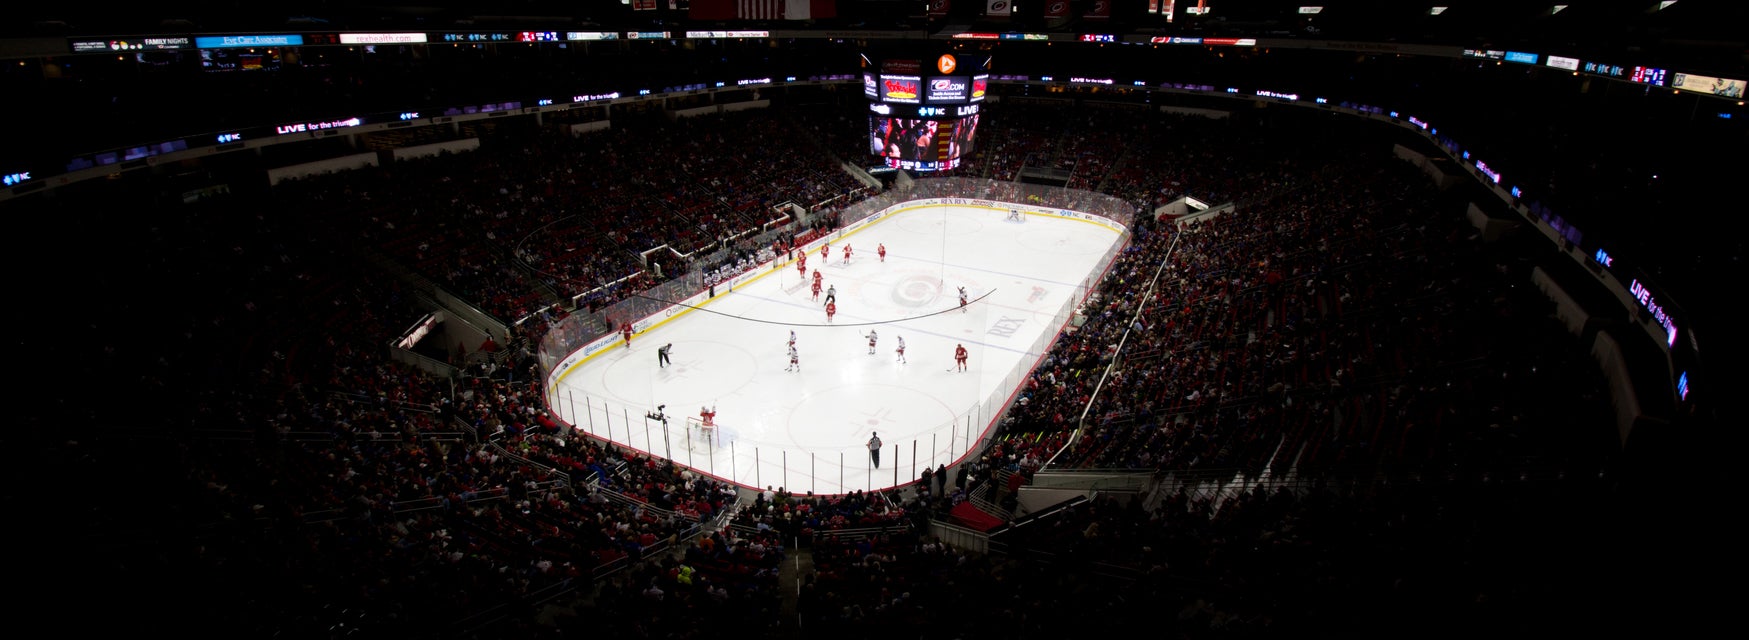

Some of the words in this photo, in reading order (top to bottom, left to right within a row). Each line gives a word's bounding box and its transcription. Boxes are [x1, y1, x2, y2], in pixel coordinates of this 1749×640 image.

[957, 105, 976, 115] LIVE
[278, 124, 306, 133] LIVE
[20, 172, 31, 180] NC
[1630, 279, 1650, 306] LIVE
[1647, 298, 1657, 314] for
[1655, 306, 1665, 324] the
[987, 316, 1027, 338] REX
[601, 335, 619, 347] LIGHT
